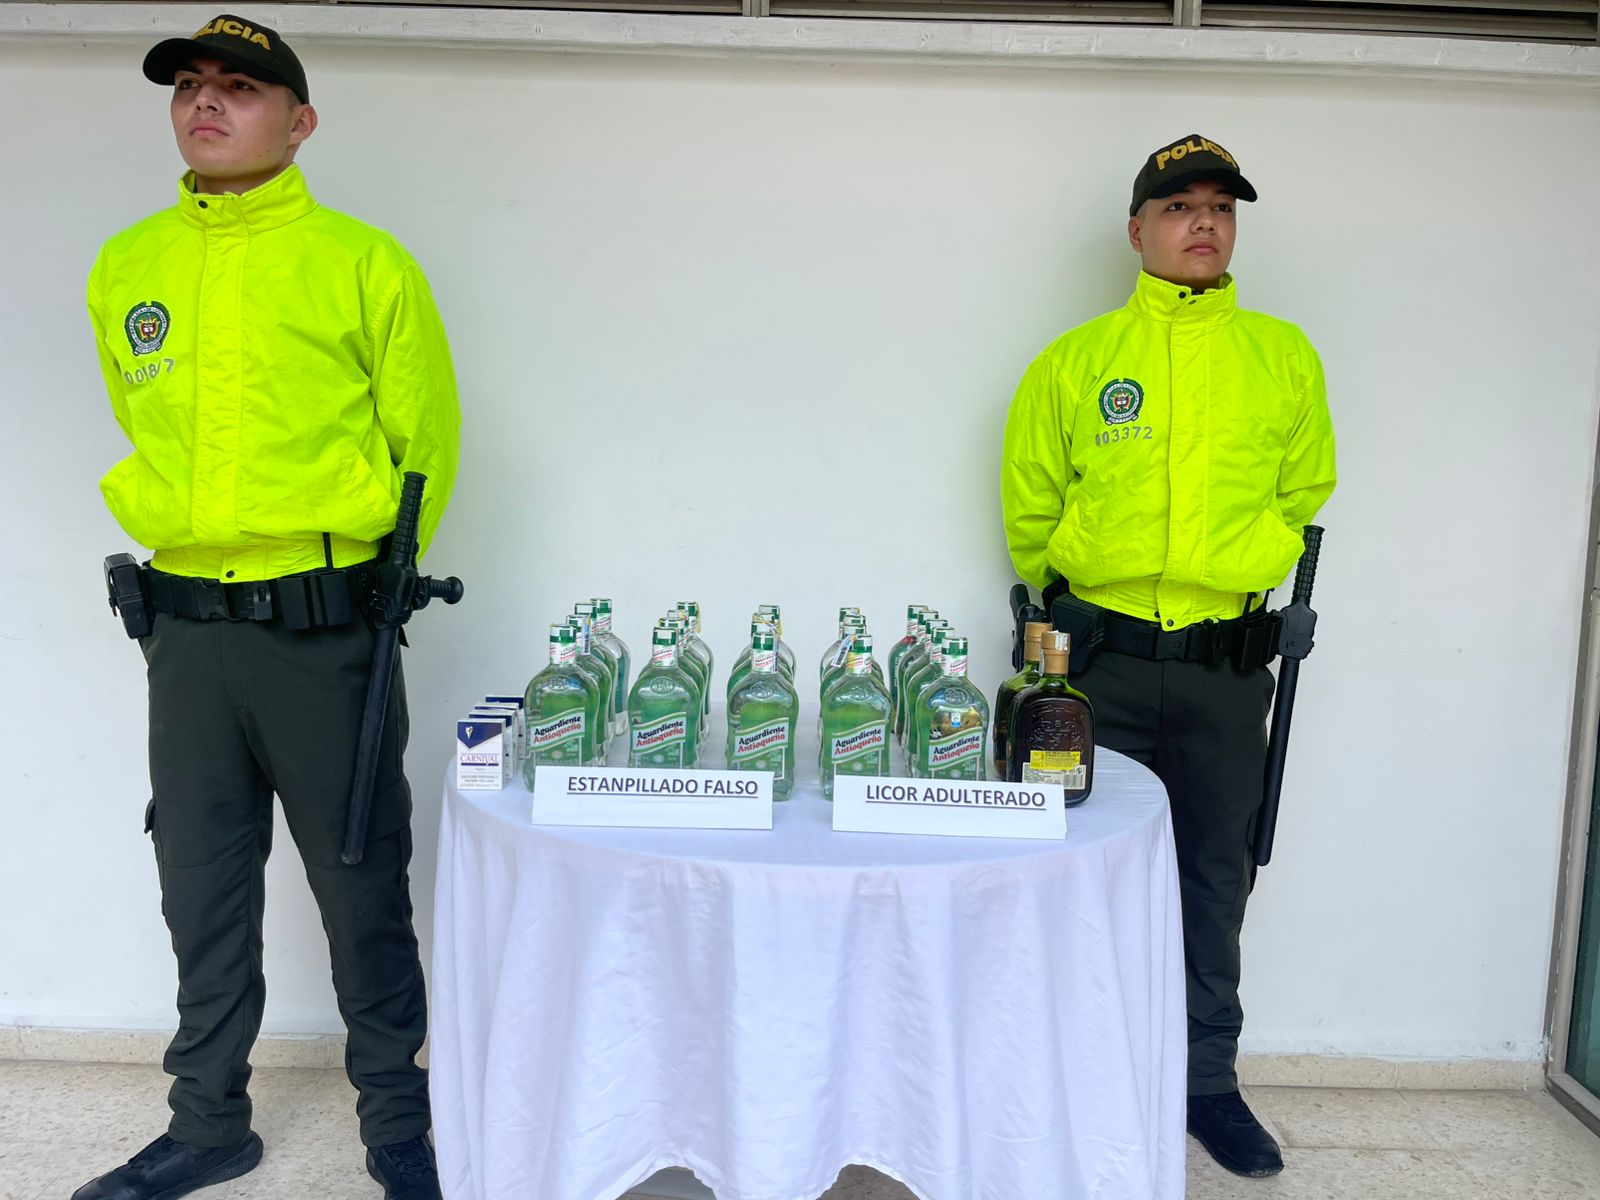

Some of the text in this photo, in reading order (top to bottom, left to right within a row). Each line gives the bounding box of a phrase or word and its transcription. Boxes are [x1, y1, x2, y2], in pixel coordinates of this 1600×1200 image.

[1095, 426, 1153, 447] 003372
[534, 716, 581, 736] Aguardiente
[637, 720, 684, 740] Aguardiente
[738, 726, 785, 746] Aguardiente
[835, 728, 882, 748] Aguardiente
[933, 735, 980, 755] Aguardiente
[460, 753, 499, 765] CARNIVAL
[567, 776, 759, 795] ESTANPILLADO FALSO
[866, 784, 1046, 807] LICOR ADULTERADO
